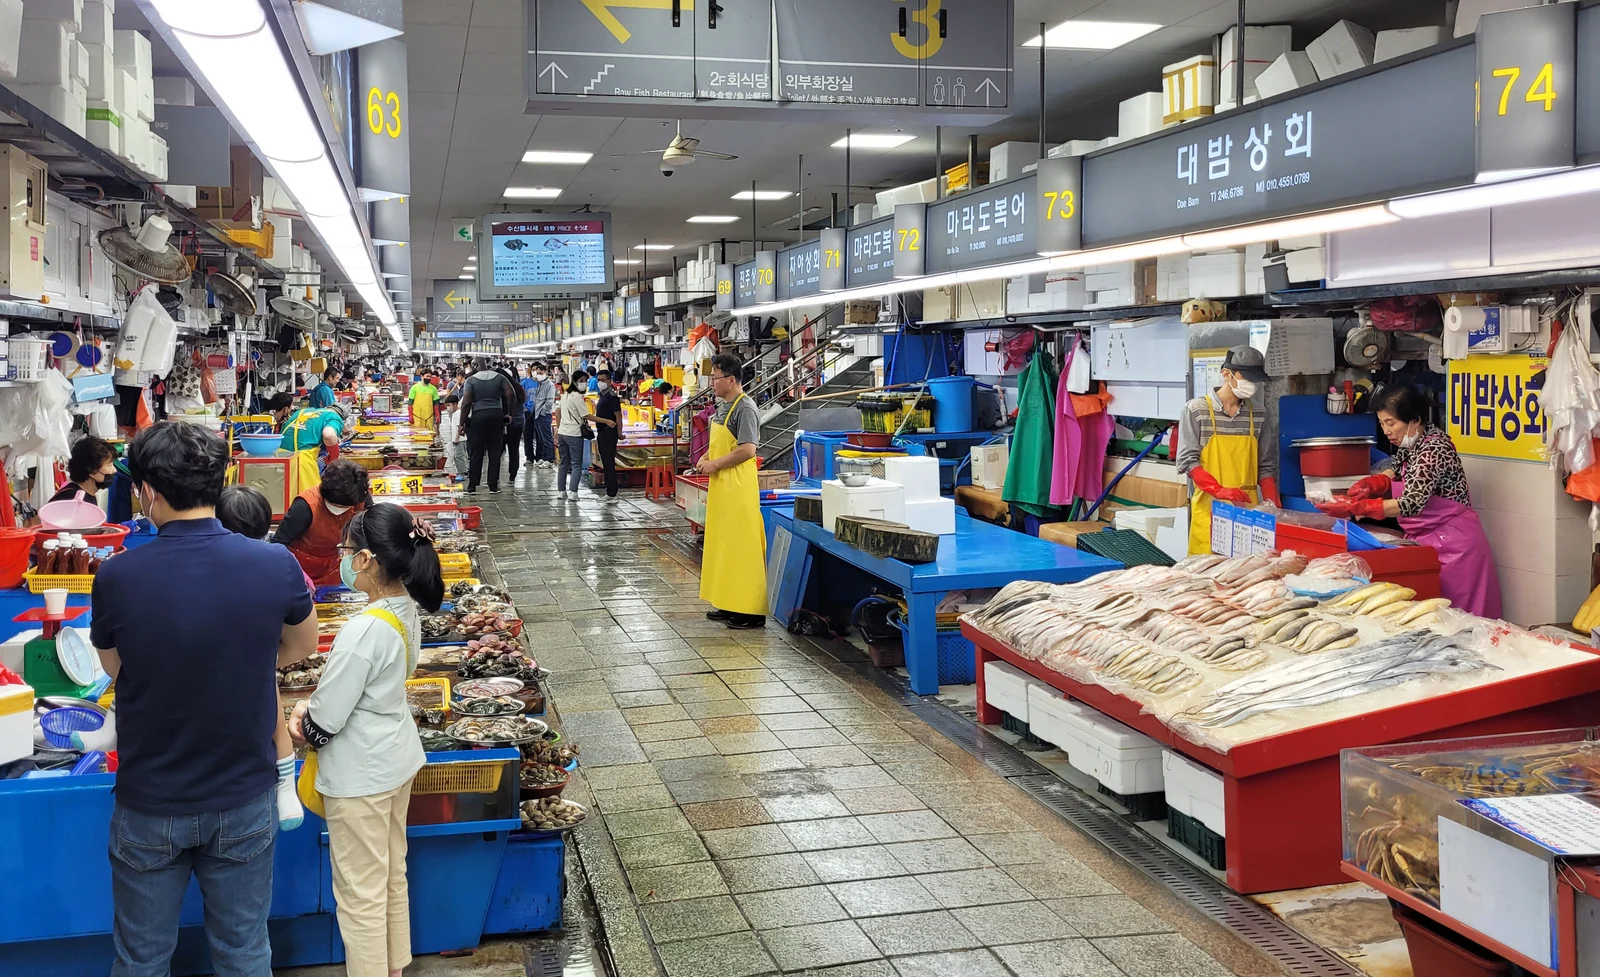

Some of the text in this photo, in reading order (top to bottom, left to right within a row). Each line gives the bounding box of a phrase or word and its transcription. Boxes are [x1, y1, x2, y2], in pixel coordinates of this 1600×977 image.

[890, 0, 943, 59] 3
[614, 87, 631, 96] Raw
[634, 88, 650, 97] Fish
[785, 74, 853, 92] 외부화장실
[1492, 62, 1557, 116] 74
[367, 86, 402, 139] 63
[1177, 111, 1312, 185] 대밤상회
[947, 192, 1025, 238] 마라도복어
[1044, 190, 1075, 220] 73
[854, 229, 895, 260] 마라도복
[898, 228, 919, 251] 72
[825, 250, 840, 268] 71
[718, 280, 731, 295] 69
[758, 269, 773, 285] 70
[1451, 372, 1548, 443] 대밤상회
